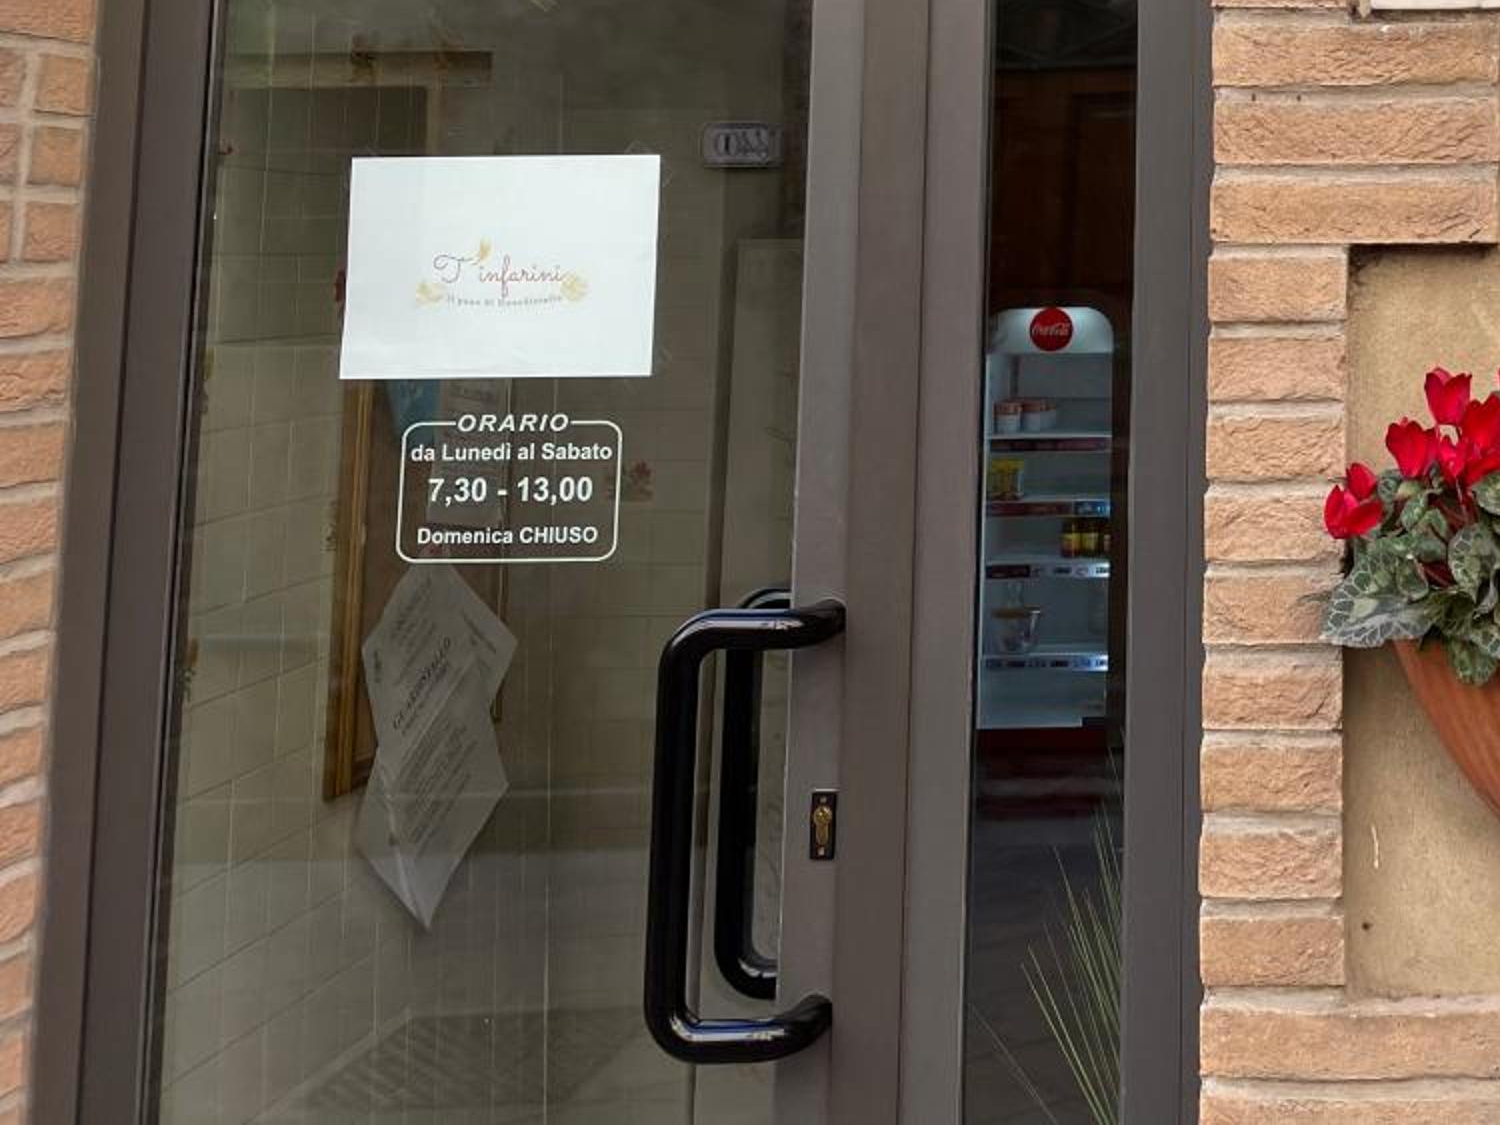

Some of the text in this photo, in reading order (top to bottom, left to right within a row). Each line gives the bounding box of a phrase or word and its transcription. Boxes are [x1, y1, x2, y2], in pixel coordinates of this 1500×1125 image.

[457, 414, 569, 432] ORARIO
[411, 442, 613, 461] da Lunedì al Sabato
[428, 478, 487, 507] 7,30
[517, 477, 593, 506] 13,00
[417, 526, 598, 544] Domenica CHIUSO
